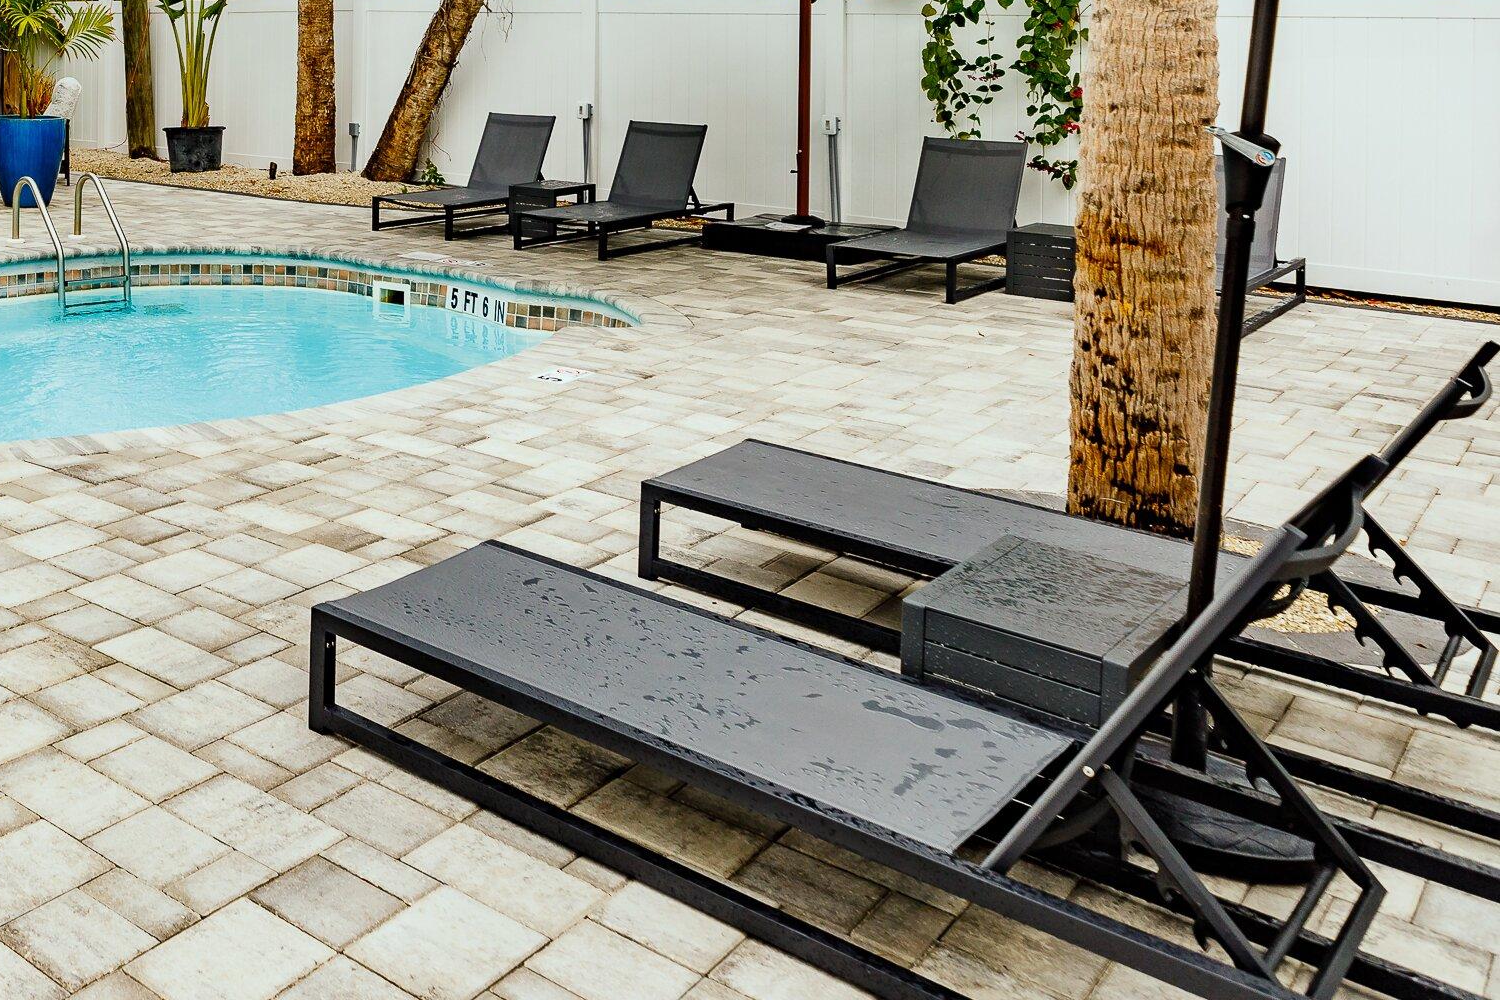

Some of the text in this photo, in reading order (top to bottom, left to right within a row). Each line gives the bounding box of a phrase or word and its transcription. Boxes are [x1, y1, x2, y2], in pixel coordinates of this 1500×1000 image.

[450, 287, 505, 323] 5 FT 6 IN
